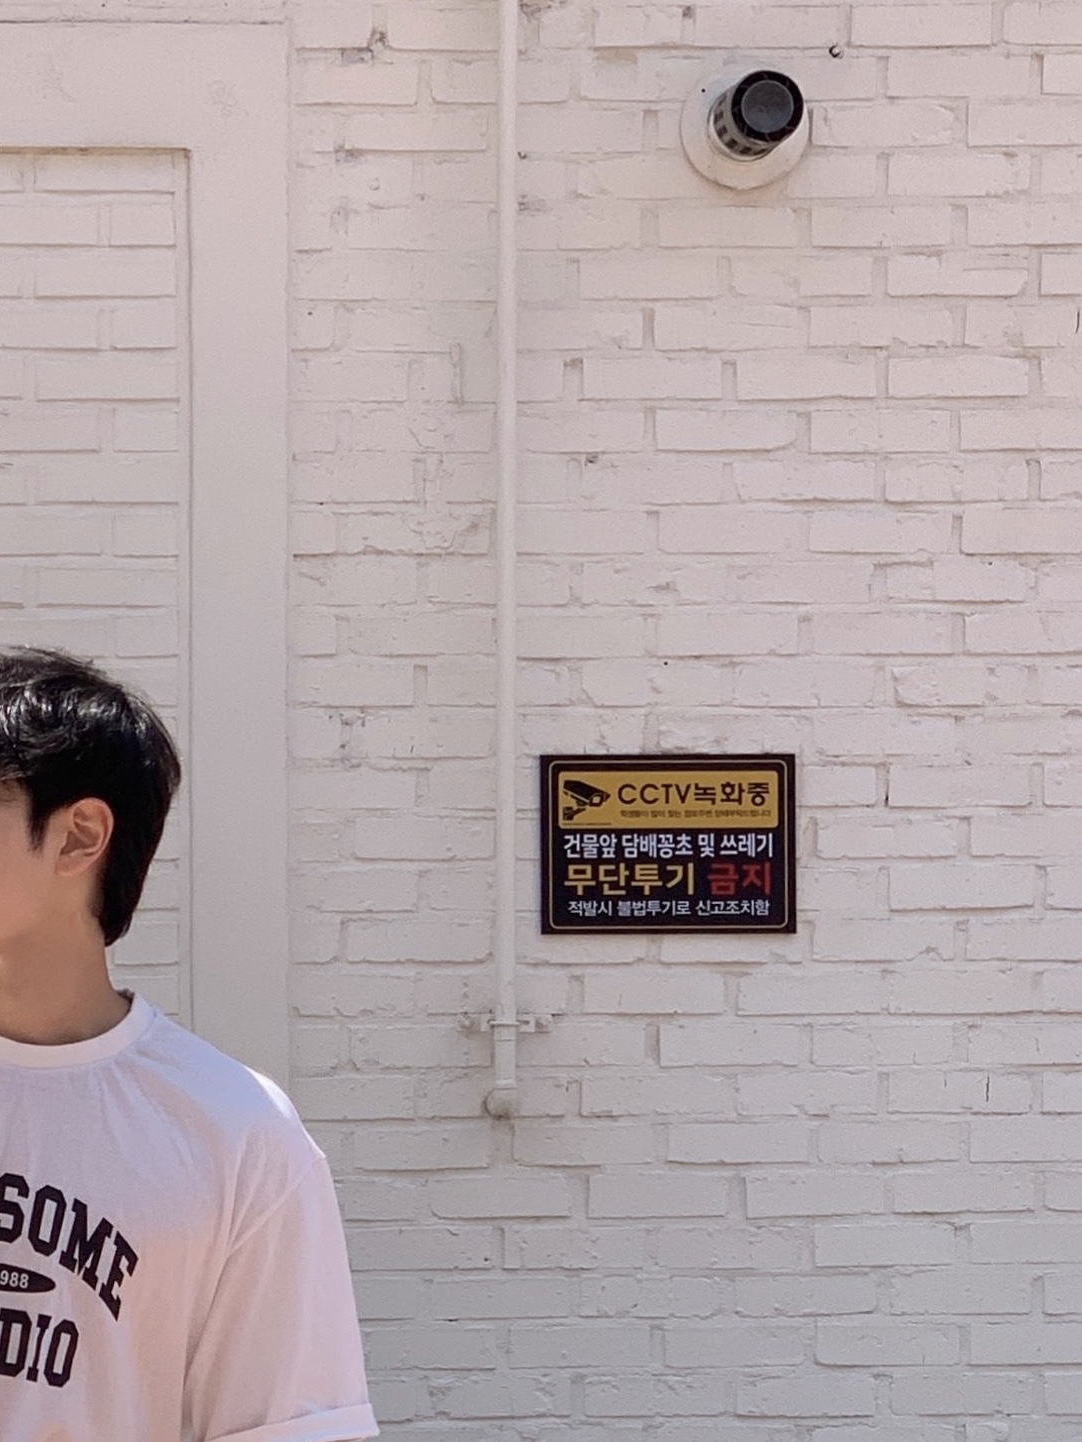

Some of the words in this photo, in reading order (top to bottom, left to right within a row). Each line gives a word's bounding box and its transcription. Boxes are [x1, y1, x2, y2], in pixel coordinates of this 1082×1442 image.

[618, 781, 770, 806] CCTV녹화중
[563, 833, 617, 859] 건물앞
[621, 833, 693, 859] 담배꽁초
[698, 833, 715, 858] 및
[719, 833, 774, 858] 쓰레기
[563, 862, 695, 896] 무단투기
[707, 862, 772, 896] 금지
[568, 900, 612, 916] 적발시
[617, 900, 692, 916] 불법투기로
[695, 900, 770, 916] 신고조치함
